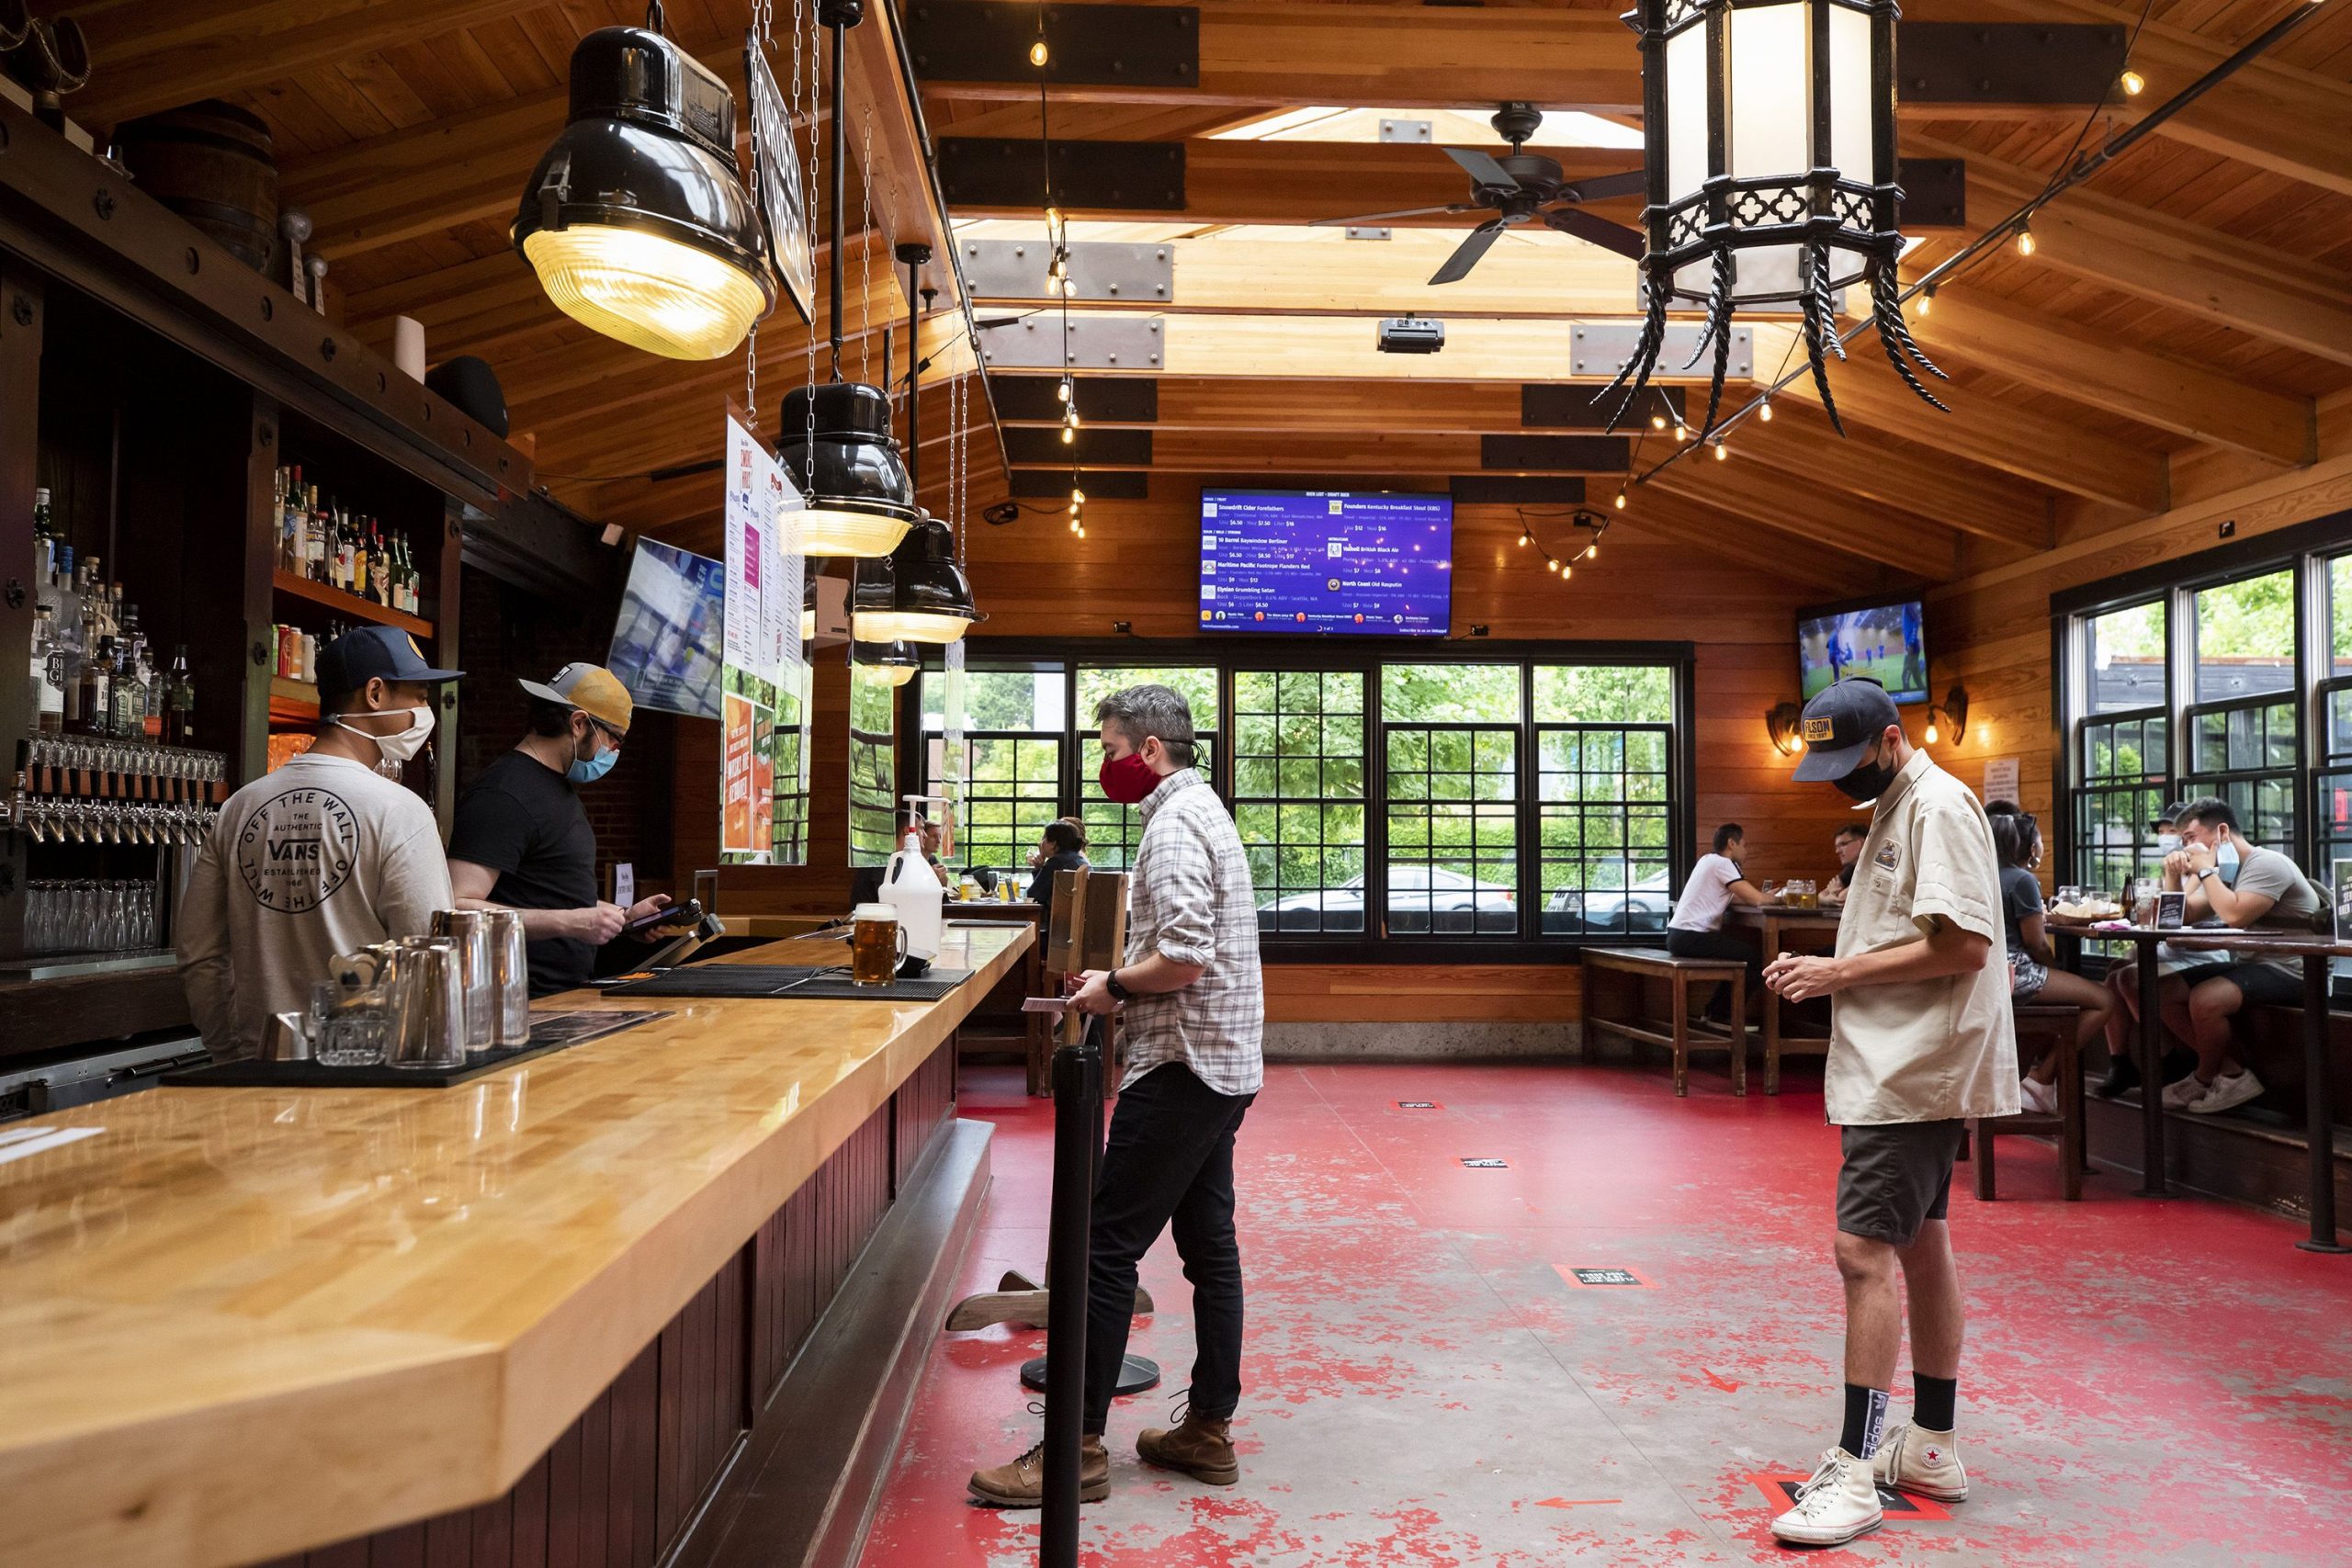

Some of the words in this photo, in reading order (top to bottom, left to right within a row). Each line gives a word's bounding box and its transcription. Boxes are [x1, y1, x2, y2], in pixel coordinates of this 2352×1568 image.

[757, 71, 800, 213] ORDER
[771, 168, 805, 287] HERE
[49, 669, 63, 681] GI
[52, 657, 63, 669] BI
[244, 809, 270, 844] OFF
[279, 792, 316, 808] THE
[323, 797, 353, 844] WALL
[274, 823, 323, 832] AUTHENTIC
[267, 838, 321, 861] VANS
[244, 859, 274, 903] WALL
[322, 859, 347, 893] OFF
[285, 893, 314, 908] THE
